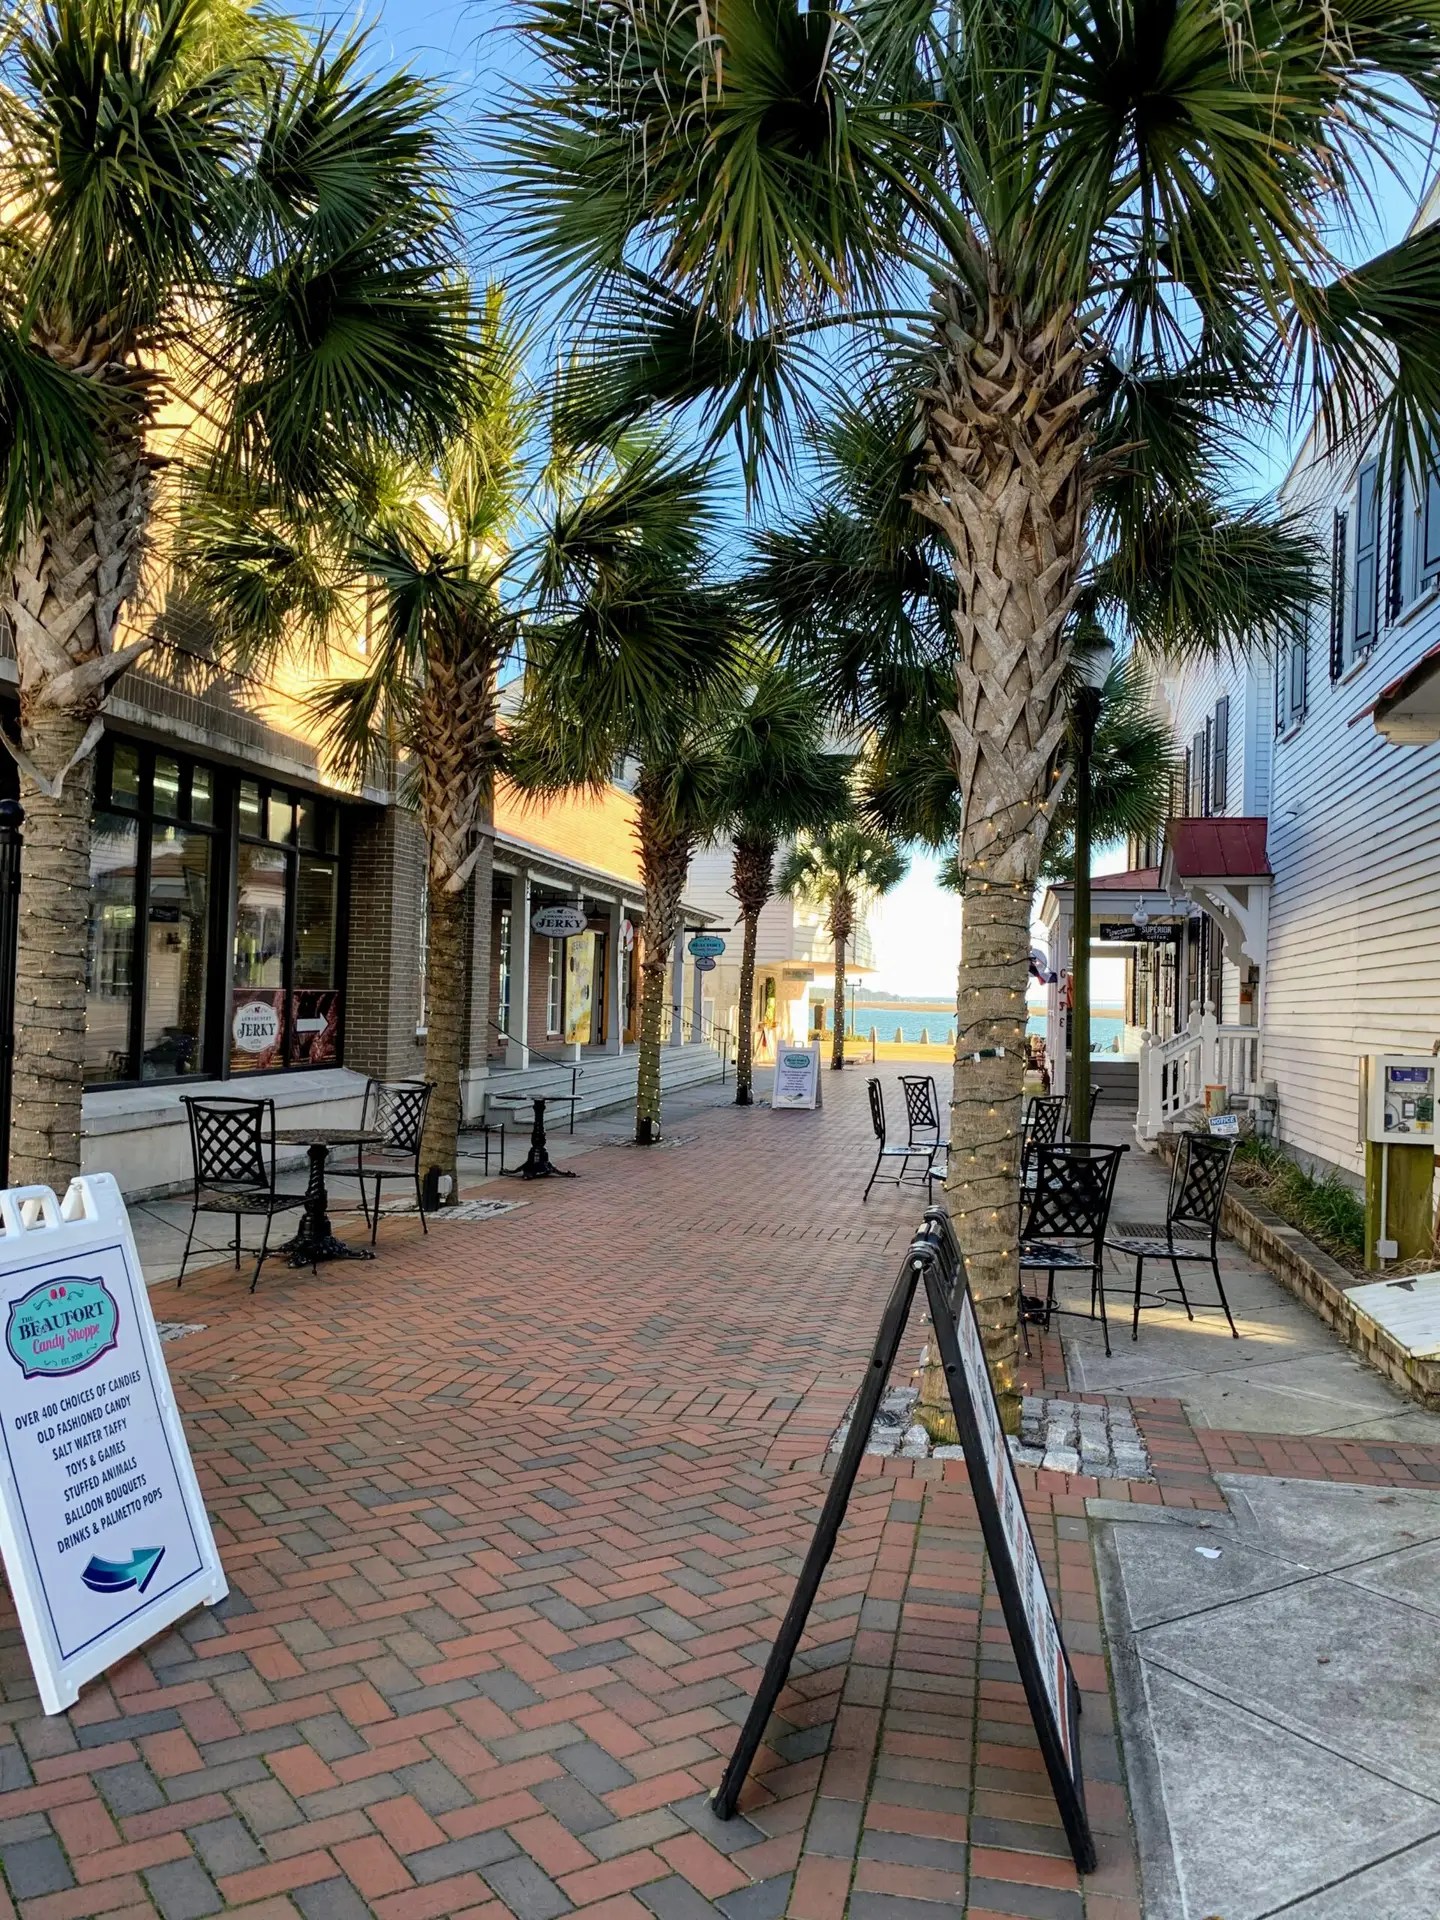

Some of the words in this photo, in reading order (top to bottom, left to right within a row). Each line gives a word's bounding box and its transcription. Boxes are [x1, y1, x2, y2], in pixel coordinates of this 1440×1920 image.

[536, 918, 583, 928] JERKY
[1141, 926, 1172, 934] SUPERIOR
[237, 1022, 276, 1039] JERKY
[1211, 1116, 1236, 1125] NOTICE
[18, 1301, 104, 1340] BEAUFORT
[33, 1334, 65, 1355] Candy
[67, 1324, 99, 1343] Shoppe
[15, 1410, 40, 1430] OVER
[42, 1403, 58, 1419] 400
[60, 1389, 95, 1412] CHOICES
[96, 1383, 108, 1397] OF
[108, 1370, 141, 1392] CANDIES
[37, 1427, 55, 1444] OLD
[57, 1407, 103, 1435] FASHIONED
[106, 1395, 132, 1415] CANDY
[52, 1442, 73, 1461] SALT
[74, 1429, 102, 1450] WATER
[104, 1418, 128, 1437] TAFFY
[65, 1458, 88, 1477] TOYS
[90, 1454, 97, 1467] &
[98, 1440, 126, 1462] GAMES
[64, 1475, 100, 1502] STUFFED
[102, 1456, 138, 1484] ANIMALS
[64, 1495, 105, 1526] BALLOON
[105, 1473, 147, 1504] BOUQUETS
[57, 1526, 91, 1554] DRINKS
[92, 1522, 100, 1535] &
[100, 1499, 141, 1530] PALMETTO
[142, 1487, 163, 1507] POPS
